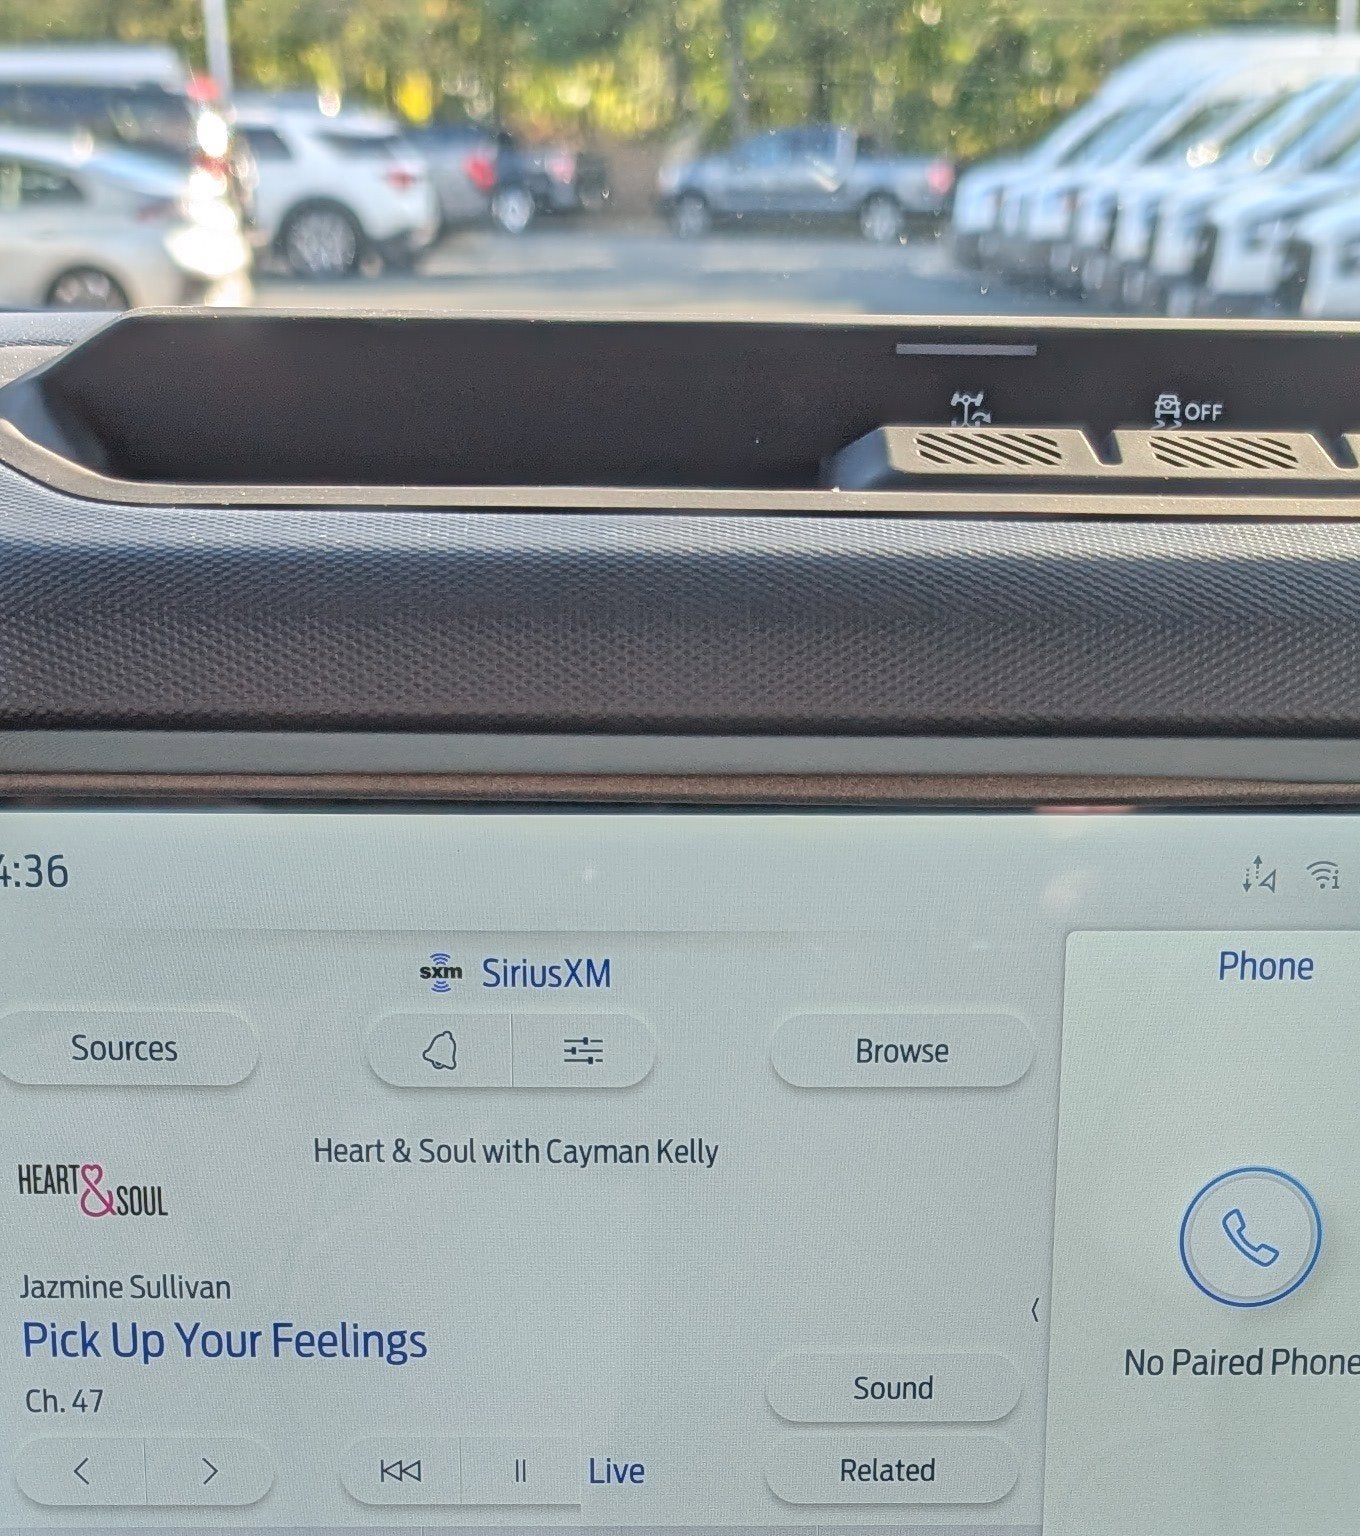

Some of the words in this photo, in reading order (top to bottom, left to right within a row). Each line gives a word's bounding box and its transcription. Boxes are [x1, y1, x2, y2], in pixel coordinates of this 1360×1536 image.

[1185, 402, 1223, 422] OFF
[419, 964, 462, 982] sxm
[482, 958, 611, 989] SiriusXM
[1219, 951, 1314, 982] Phone
[71, 1034, 178, 1062] Sources
[856, 1037, 949, 1065] Browse
[314, 1138, 386, 1164] Heart
[392, 1139, 411, 1164] &
[419, 1138, 476, 1164] Soul
[482, 1138, 540, 1164] with
[546, 1139, 649, 1169] Cayman
[657, 1138, 719, 1169] Kelly
[20, 1275, 123, 1301] Jazmine
[130, 1275, 231, 1301] Sullivan
[23, 1321, 101, 1359] Pick
[112, 1322, 164, 1364] Up
[174, 1322, 261, 1359] Your
[273, 1321, 428, 1366] Feelings
[1124, 1350, 1164, 1376] No
[1173, 1348, 1264, 1376] Paired
[26, 1388, 66, 1414] Ch.
[72, 1389, 104, 1414] 47
[853, 1375, 933, 1401] Sound
[590, 1458, 645, 1484] Live
[841, 1458, 936, 1483] Related
